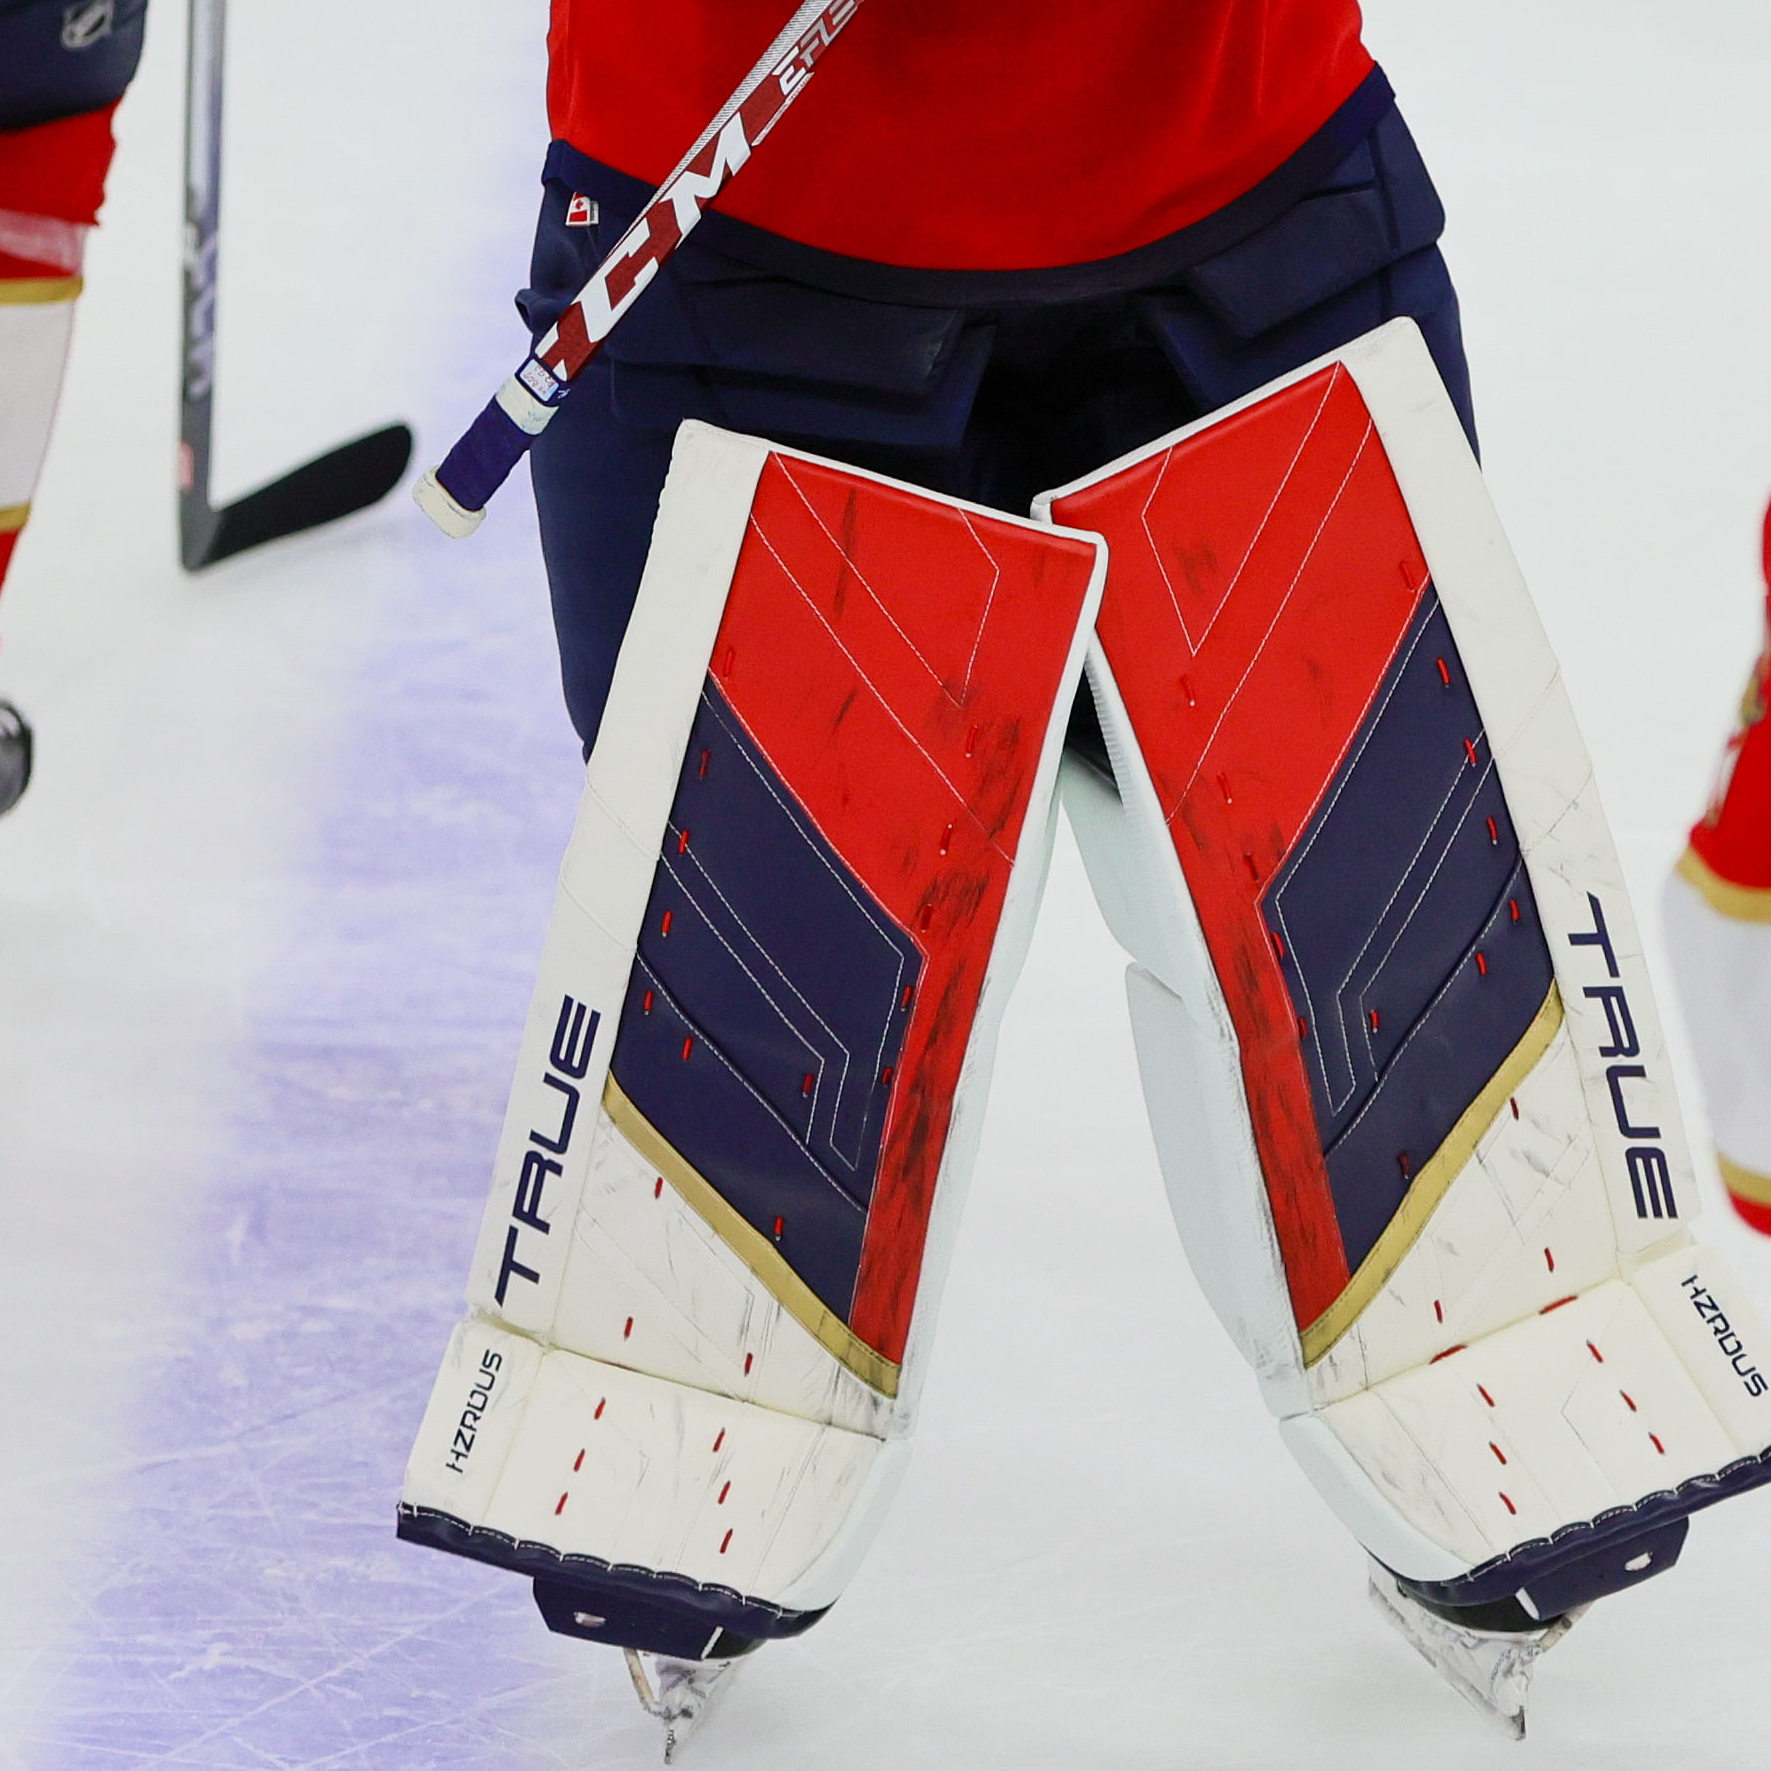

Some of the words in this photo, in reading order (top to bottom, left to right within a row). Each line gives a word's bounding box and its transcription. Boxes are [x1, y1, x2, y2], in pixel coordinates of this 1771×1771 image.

[534, 111, 752, 381] CM
[494, 993, 602, 1308] TRUE
[1567, 891, 1679, 1219] TRUE
[445, 1348, 504, 1475] HZRDUS
[1681, 1274, 1769, 1398] HZRDUS
